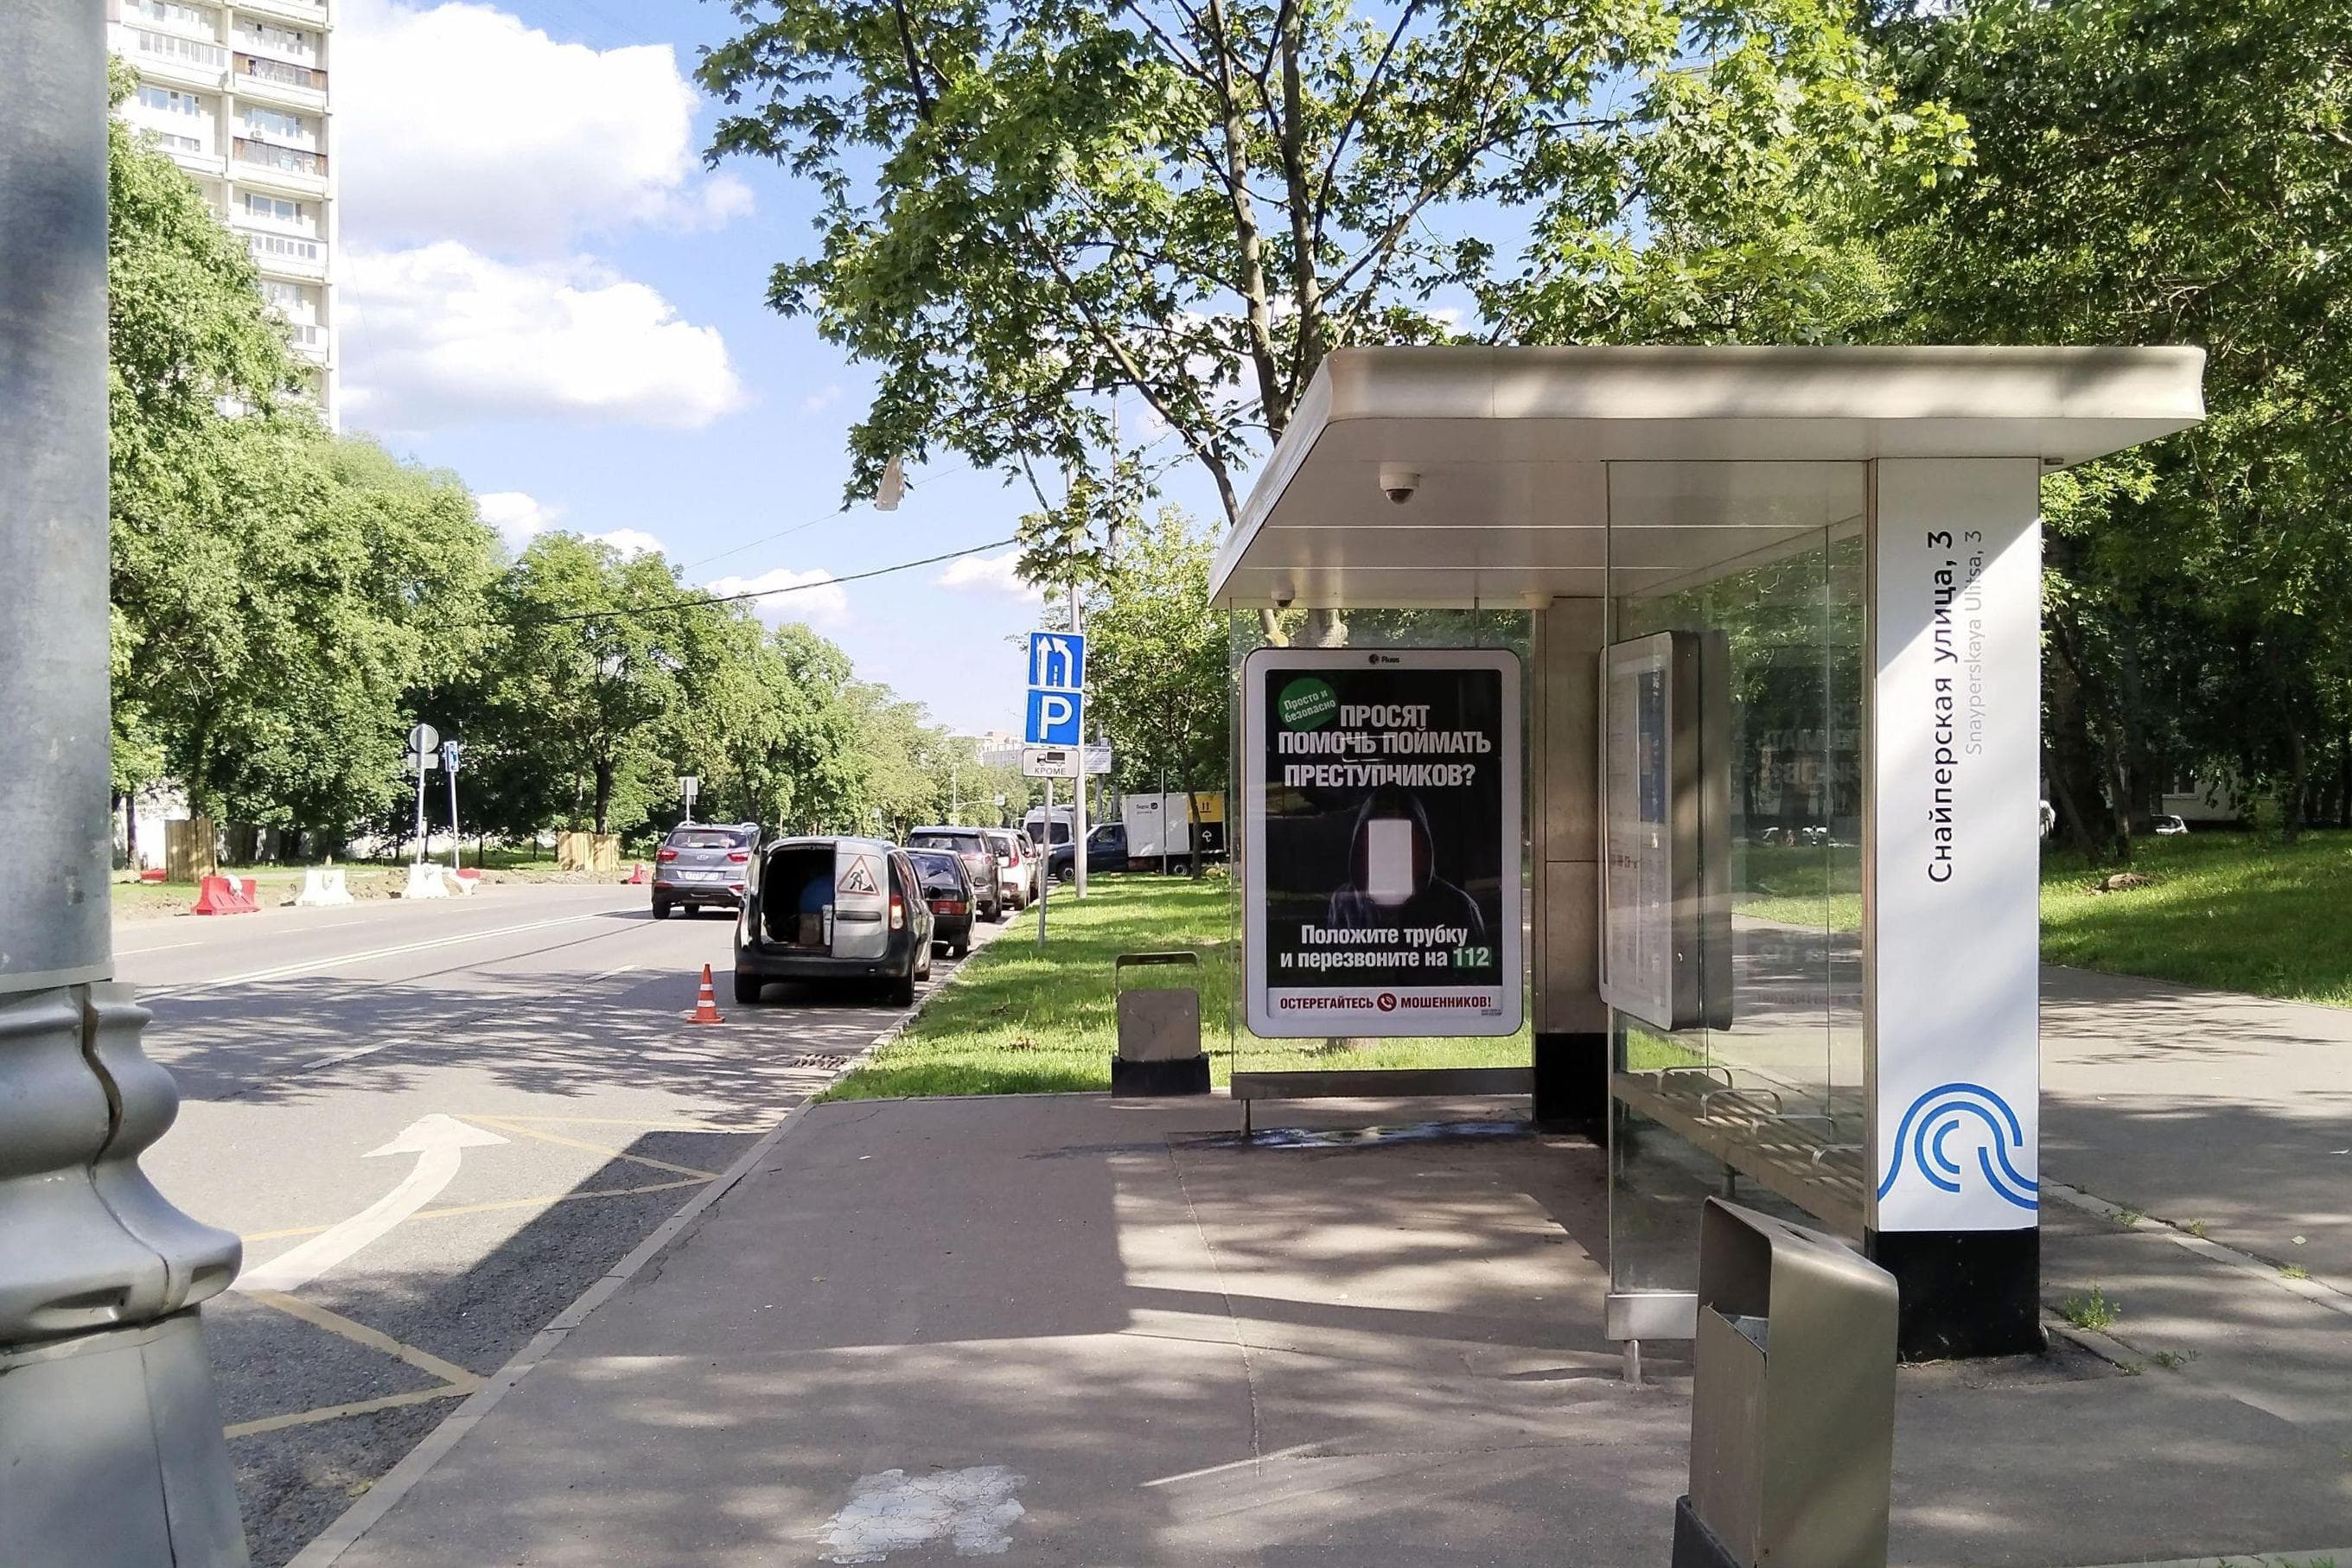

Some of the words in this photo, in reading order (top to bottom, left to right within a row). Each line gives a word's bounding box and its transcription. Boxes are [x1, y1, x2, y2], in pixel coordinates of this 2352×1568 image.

[1928, 530, 1953, 549] 3
[1965, 530, 1982, 543] 3
[1965, 551, 1984, 611] Ulitsa,
[1935, 560, 1958, 664] улица,
[1965, 619, 1985, 755] Snayperskaya
[1284, 694, 1319, 711] Просто
[1284, 699, 1336, 723] безопасно
[1341, 704, 1430, 728] ПРОСЯТ
[1278, 731, 1376, 754] ПОМОЧЬ
[1383, 726, 1491, 754] ПОЙМАТЬ
[1284, 764, 1476, 787] ПРЕСТУПНИКОВ?
[1928, 679, 1958, 883] Снайперская
[1301, 925, 1399, 944] Положите
[1403, 925, 1468, 947] трубку
[1281, 953, 1292, 967] и
[1298, 950, 1419, 972] перезвоните
[1425, 952, 1448, 966] на
[1453, 947, 1489, 966] 112
[1280, 995, 1374, 1010] ОСТЕРЕГАЙТЕСЬ
[1400, 996, 1492, 1009] МОШЕННИКОВ!
